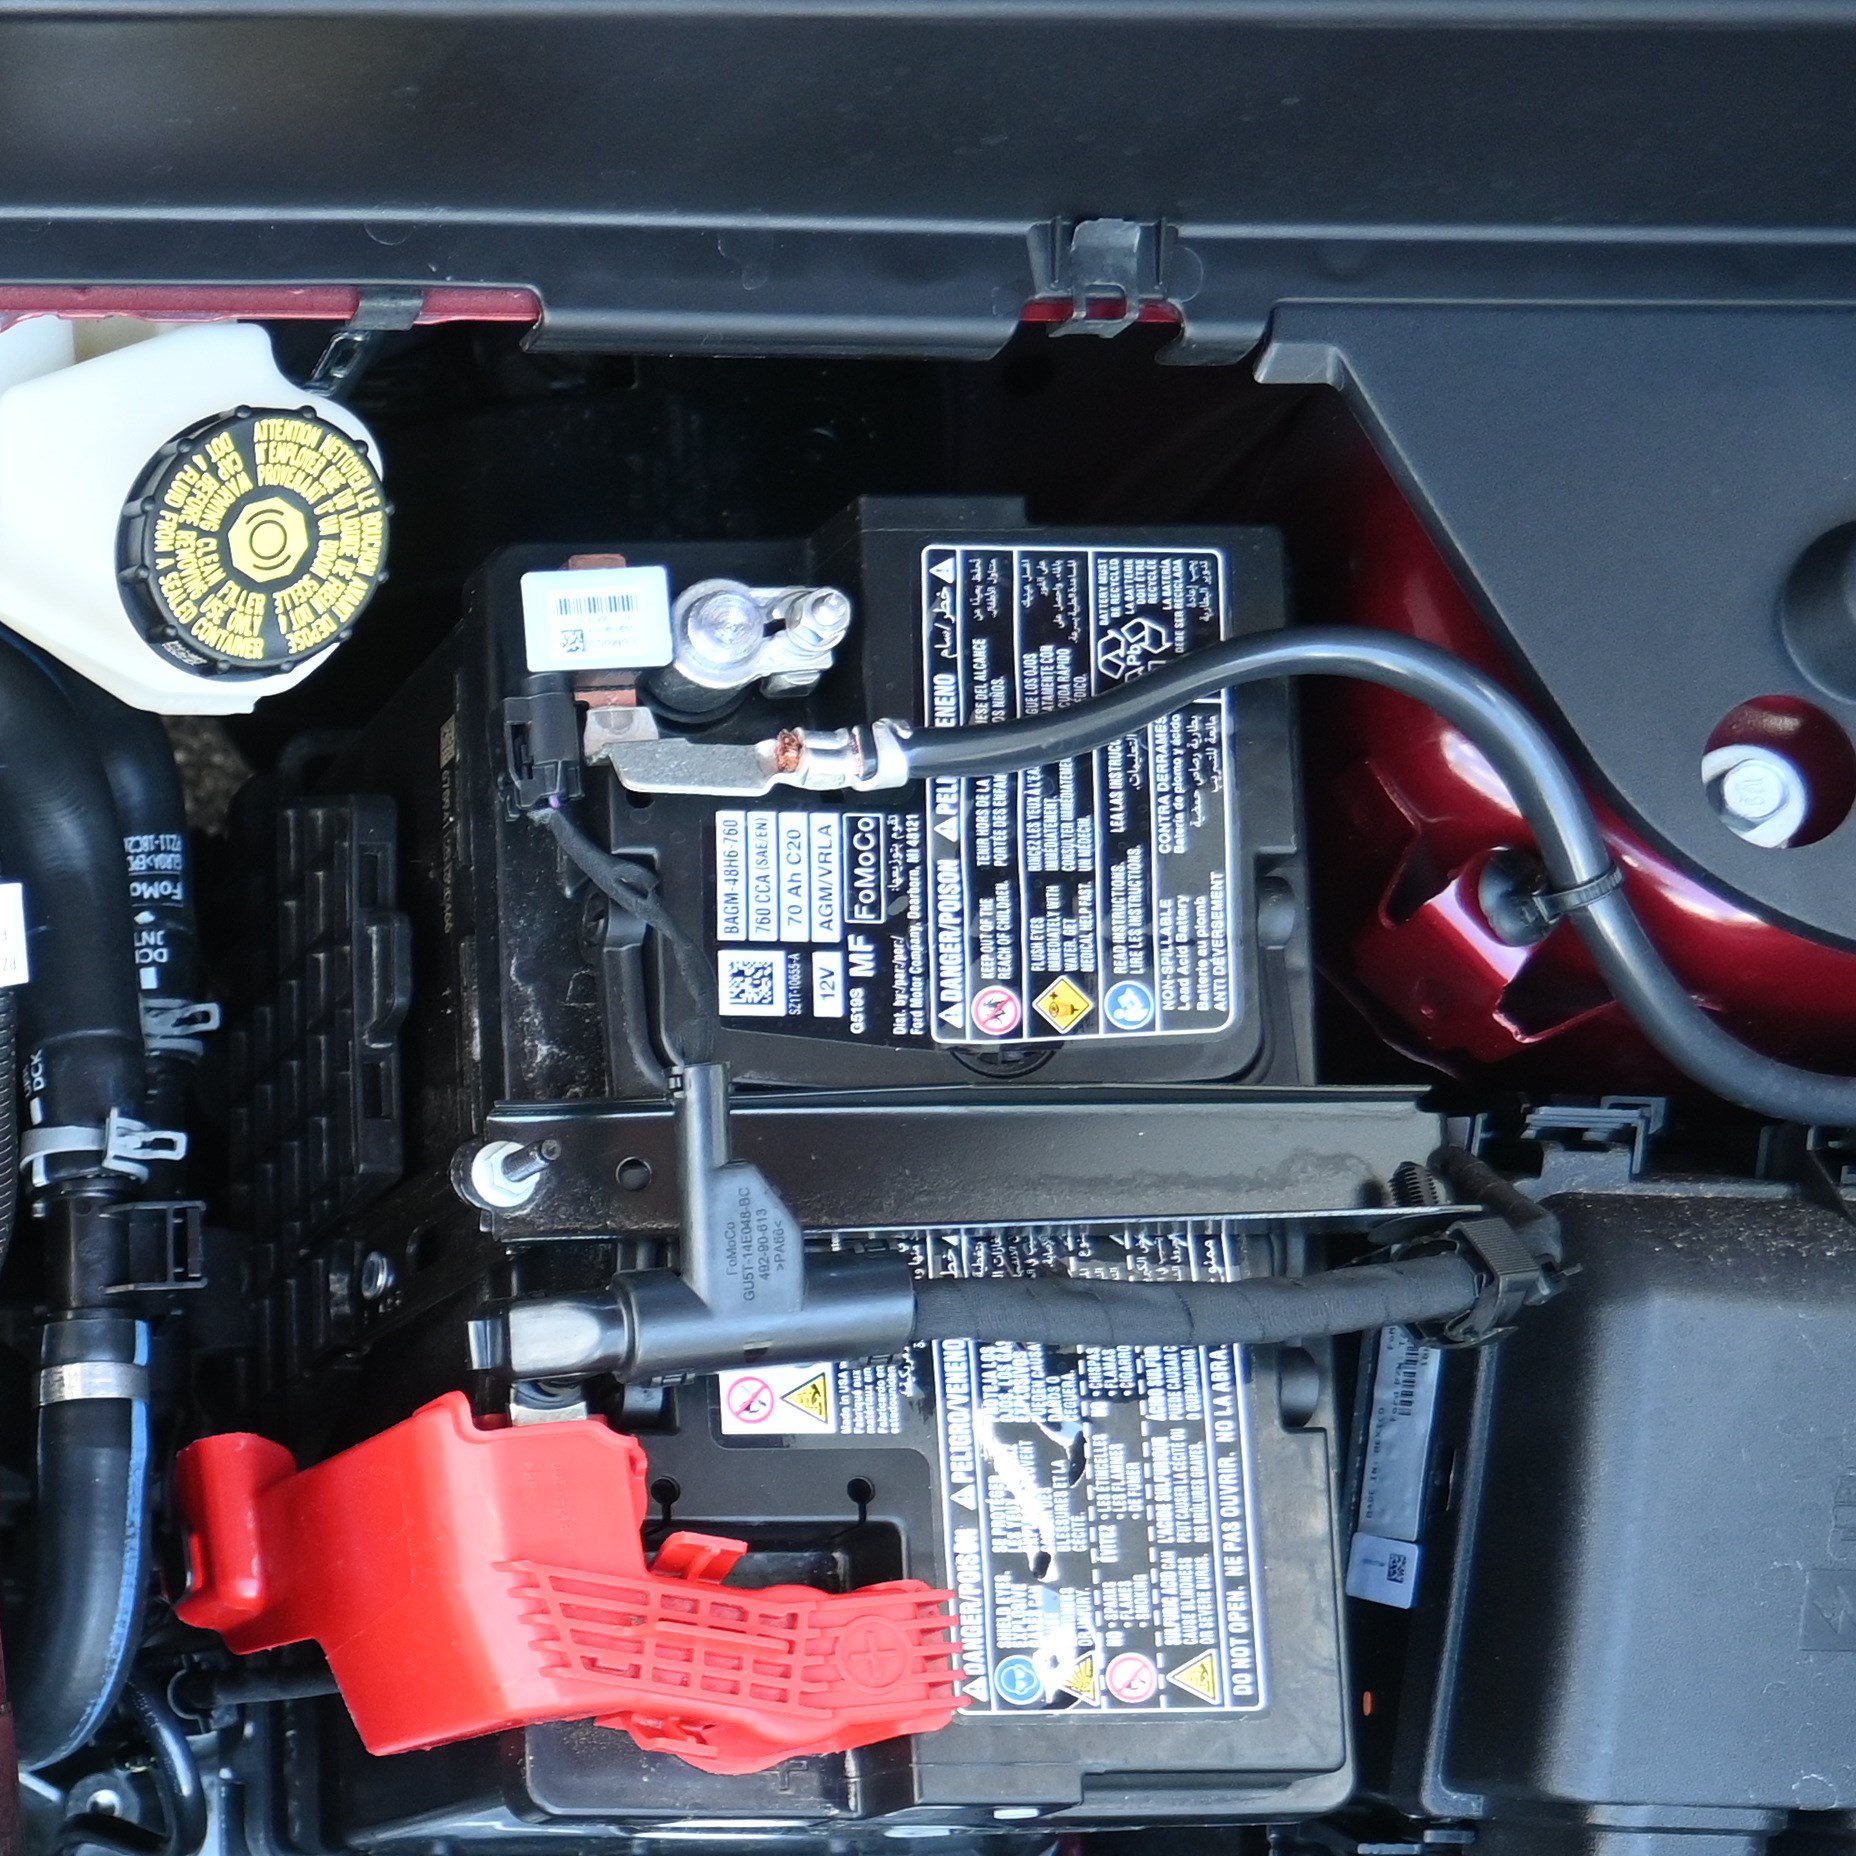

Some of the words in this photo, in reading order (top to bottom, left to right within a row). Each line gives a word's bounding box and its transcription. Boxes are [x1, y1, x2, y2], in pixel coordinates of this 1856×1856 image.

[205, 431, 234, 462] DOT
[254, 418, 322, 447] ATTENTION
[218, 451, 245, 481] CAP
[318, 433, 372, 492] NETTOYER
[163, 464, 201, 508] FLUID
[320, 465, 346, 493] QUE
[179, 473, 220, 526] BEFORE
[199, 471, 252, 531] WARNING
[332, 488, 355, 510] DU
[356, 488, 379, 511] LE
[154, 510, 178, 551] FROM
[257, 464, 327, 505] PROVENANT
[309, 539, 339, 579] BIDON
[338, 509, 362, 557] LIQUIDE
[355, 511, 382, 576] BOUCHON
[155, 558, 174, 569] A
[175, 530, 209, 600] REMOVING
[196, 537, 226, 586] CLEAN
[331, 558, 356, 579] DE
[1098, 558, 1109, 584] MUST
[158, 571, 197, 624] SEALED
[199, 593, 228, 623] USE
[217, 580, 265, 615] FILLER
[309, 576, 346, 614] FREIN
[331, 576, 368, 622] AVANT
[1098, 586, 1109, 625] BATTERY
[226, 609, 262, 636] ONLY
[288, 603, 315, 630] DOT
[1111, 605, 1120, 618] BE
[191, 616, 263, 658] CONTAINER
[1127, 645, 1141, 666] Pb
[906, 814, 920, 847] 48121
[786, 829, 801, 865] C20
[906, 850, 920, 863] MI
[722, 819, 740, 934] BAGM-48H6-760
[817, 824, 834, 931] AGM/VRLA
[853, 817, 876, 919] FoMoCo
[755, 874, 770, 903] CCA
[787, 872, 802, 897] Ah
[908, 866, 923, 919] Dearborn,
[787, 904, 802, 926] 70
[980, 898, 994, 917] THE
[995, 880, 1010, 931] CHILDREN.
[1079, 908, 1094, 930] HELP
[1176, 895, 1190, 943] Battery
[1195, 896, 1210, 937] plomb
[755, 908, 771, 934] 760
[937, 859, 963, 1002] DANGER/POISON
[981, 919, 994, 932] OF
[1030, 917, 1044, 940] EYES
[1063, 918, 1076, 936] GET
[1209, 872, 1226, 975] DÉVERSEMENT
[908, 922, 924, 974] Company,
[981, 934, 994, 953] OUT
[997, 933, 1011, 945] OF
[1128, 929, 1143, 948] LES
[1198, 940, 1208, 956] au
[848, 934, 875, 977] MF
[981, 955, 995, 979] KEEP
[997, 951, 1012, 979] REACH
[1030, 943, 1045, 971] FLUSH
[1112, 945, 1127, 973] READ
[1129, 951, 1143, 974] LIRE
[1160, 899, 1175, 1010] NON-SPILLABLE
[1177, 946, 1190, 975] Acid
[819, 967, 835, 1001] 12V
[909, 977, 923, 1006] Motor
[1177, 979, 1190, 1010] Lead
[1196, 960, 1210, 1010] Batterie
[1212, 979, 1227, 1011] ANTI
[892, 1010, 906, 1035] Dist.
[910, 1011, 924, 1035] Ford
[721, 1221, 738, 1275] FoMoCo
[838, 1371, 849, 1393] USA
[1208, 1344, 1229, 1392] ABRA.
[839, 1395, 850, 1405] in
[942, 1339, 975, 1483] PELIGRO/VENENO
[1211, 1396, 1232, 1416] LA
[1213, 1420, 1234, 1442] NO
[1219, 1452, 1240, 1517] OUVRIR.
[1223, 1522, 1243, 1552] PAS
[1225, 1555, 1245, 1576] NE
[1228, 1585, 1249, 1633] OPEN.
[1231, 1637, 1250, 1669] NOT
[1232, 1672, 1252, 1696] DO
